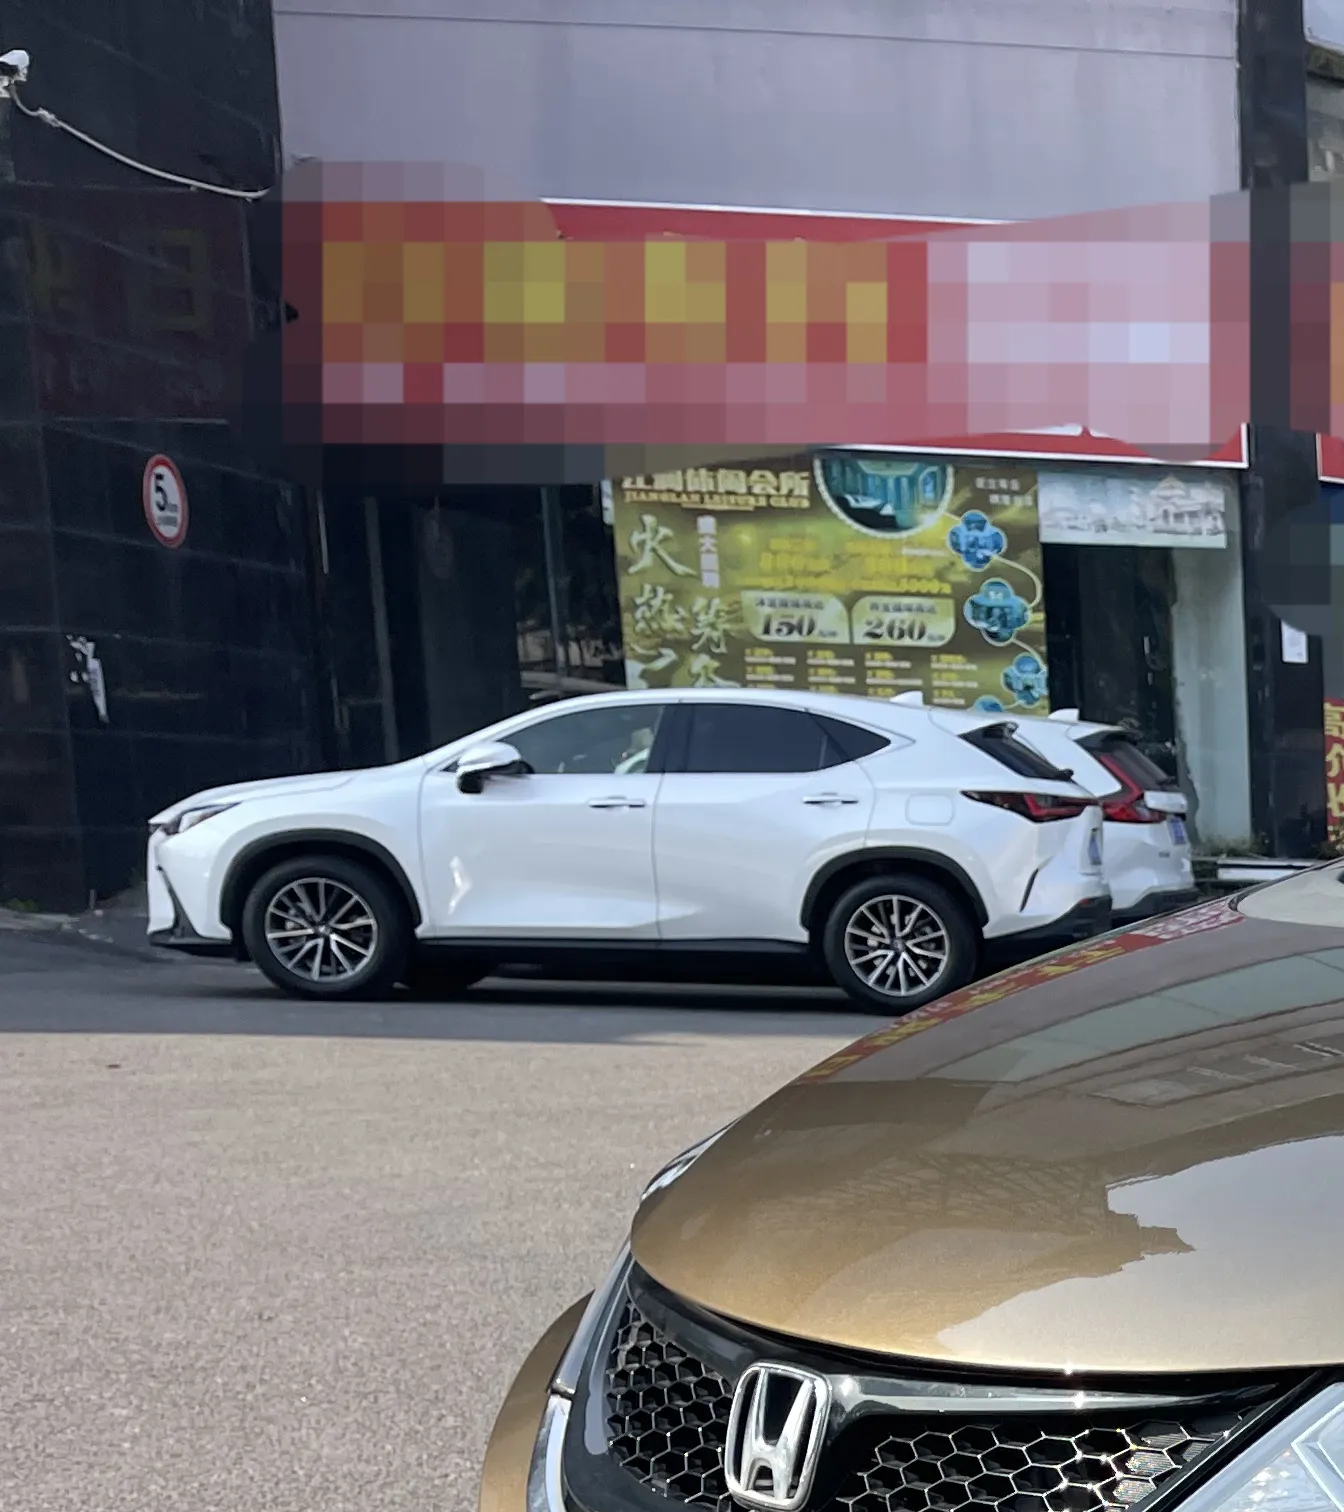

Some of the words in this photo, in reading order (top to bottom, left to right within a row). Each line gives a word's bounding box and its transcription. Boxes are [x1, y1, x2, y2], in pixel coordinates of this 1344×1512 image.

[154, 473, 168, 512] 5
[761, 613, 816, 637] 150
[862, 616, 927, 642] 260
